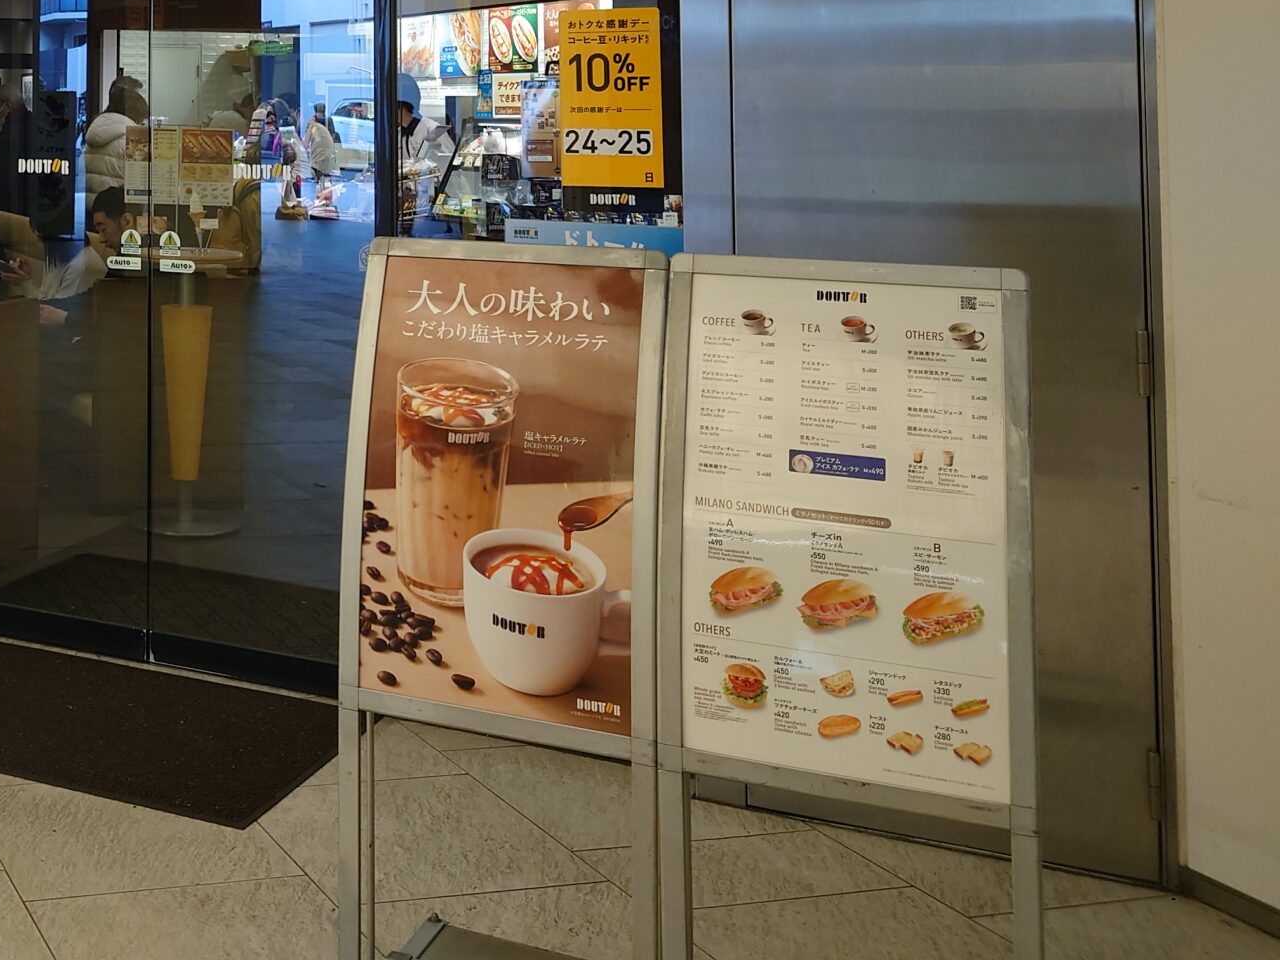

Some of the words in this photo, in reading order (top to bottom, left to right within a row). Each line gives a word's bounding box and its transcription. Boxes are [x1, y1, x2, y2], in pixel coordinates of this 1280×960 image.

[568, 18, 650, 29] おトクな感謝デー
[614, 76, 650, 92] OFF
[18, 158, 70, 175] DOUTOR
[233, 164, 291, 181] DOUTOR
[645, 172, 654, 183] 日
[590, 193, 636, 206] DOUTOR
[565, 230, 644, 248] ドトー
[407, 279, 611, 322] 大人の味わい
[816, 290, 867, 303] DOUTOR
[702, 316, 736, 327] COFFEE
[801, 323, 821, 333] TEA
[402, 320, 608, 352] こだわり塩キャラメルラテ
[905, 330, 944, 341] OTHERS
[524, 431, 587, 446] 塩キャラメルラテ
[815, 456, 840, 464] プレミアム
[695, 496, 733, 510] MILANO
[736, 501, 790, 517] SANDWICH
[726, 518, 733, 527] A
[811, 532, 842, 541] チーズin
[933, 543, 941, 552] B
[492, 613, 546, 639] DOUTOR
[694, 622, 731, 636] OTHERS
[577, 698, 621, 716] DOUTOR
[870, 714, 887, 722] トースト
[934, 725, 968, 735] チーズトースト
